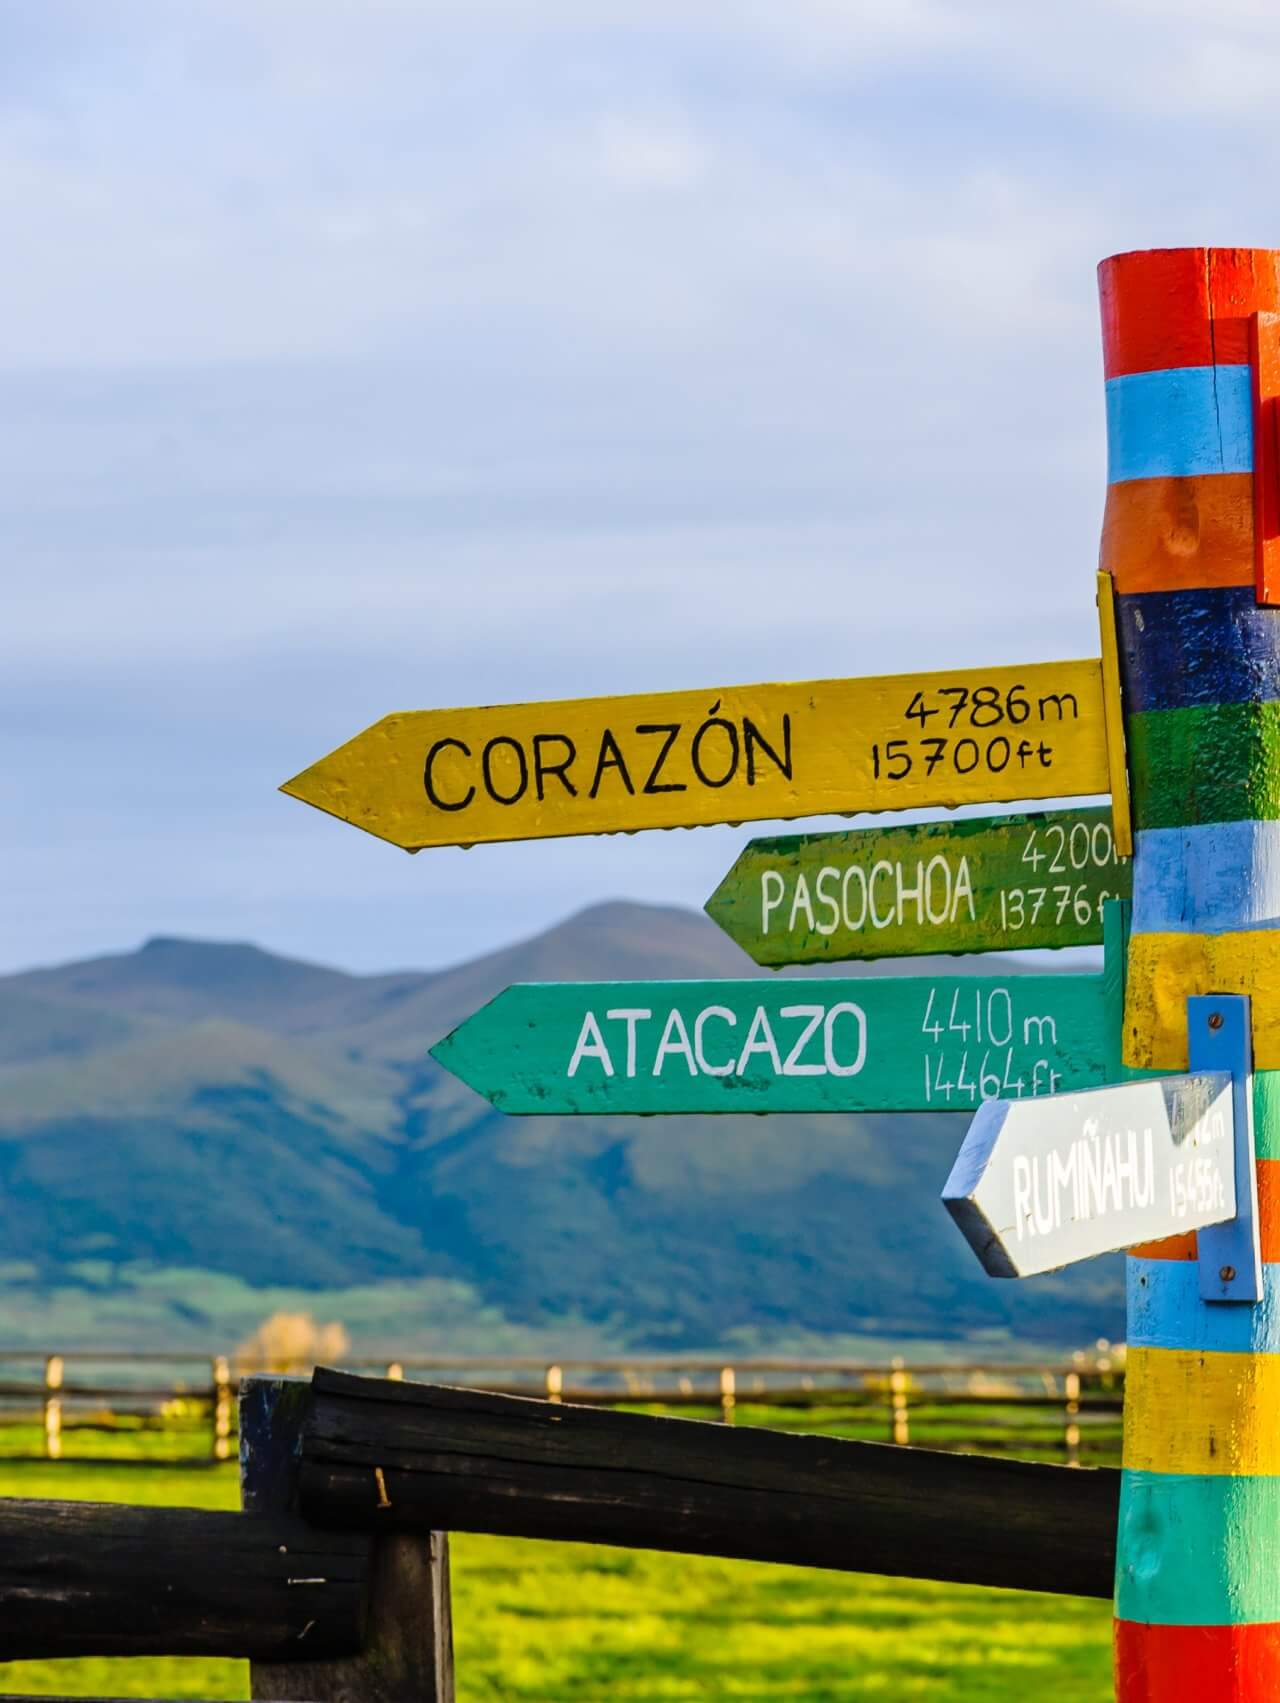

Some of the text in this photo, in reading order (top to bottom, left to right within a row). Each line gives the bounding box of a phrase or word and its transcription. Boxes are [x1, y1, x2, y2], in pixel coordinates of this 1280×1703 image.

[904, 685, 1079, 729] 4786m
[424, 699, 792, 811] CORAZÓN
[872, 736, 1053, 780] 15700ft
[761, 855, 976, 936] PASOCHOA
[1000, 884, 1120, 932] 13776f
[567, 1001, 867, 1077] ATACAZO
[924, 1046, 1063, 1103] 14464ft
[1013, 1113, 1155, 1243] RUMIÑAHUI
